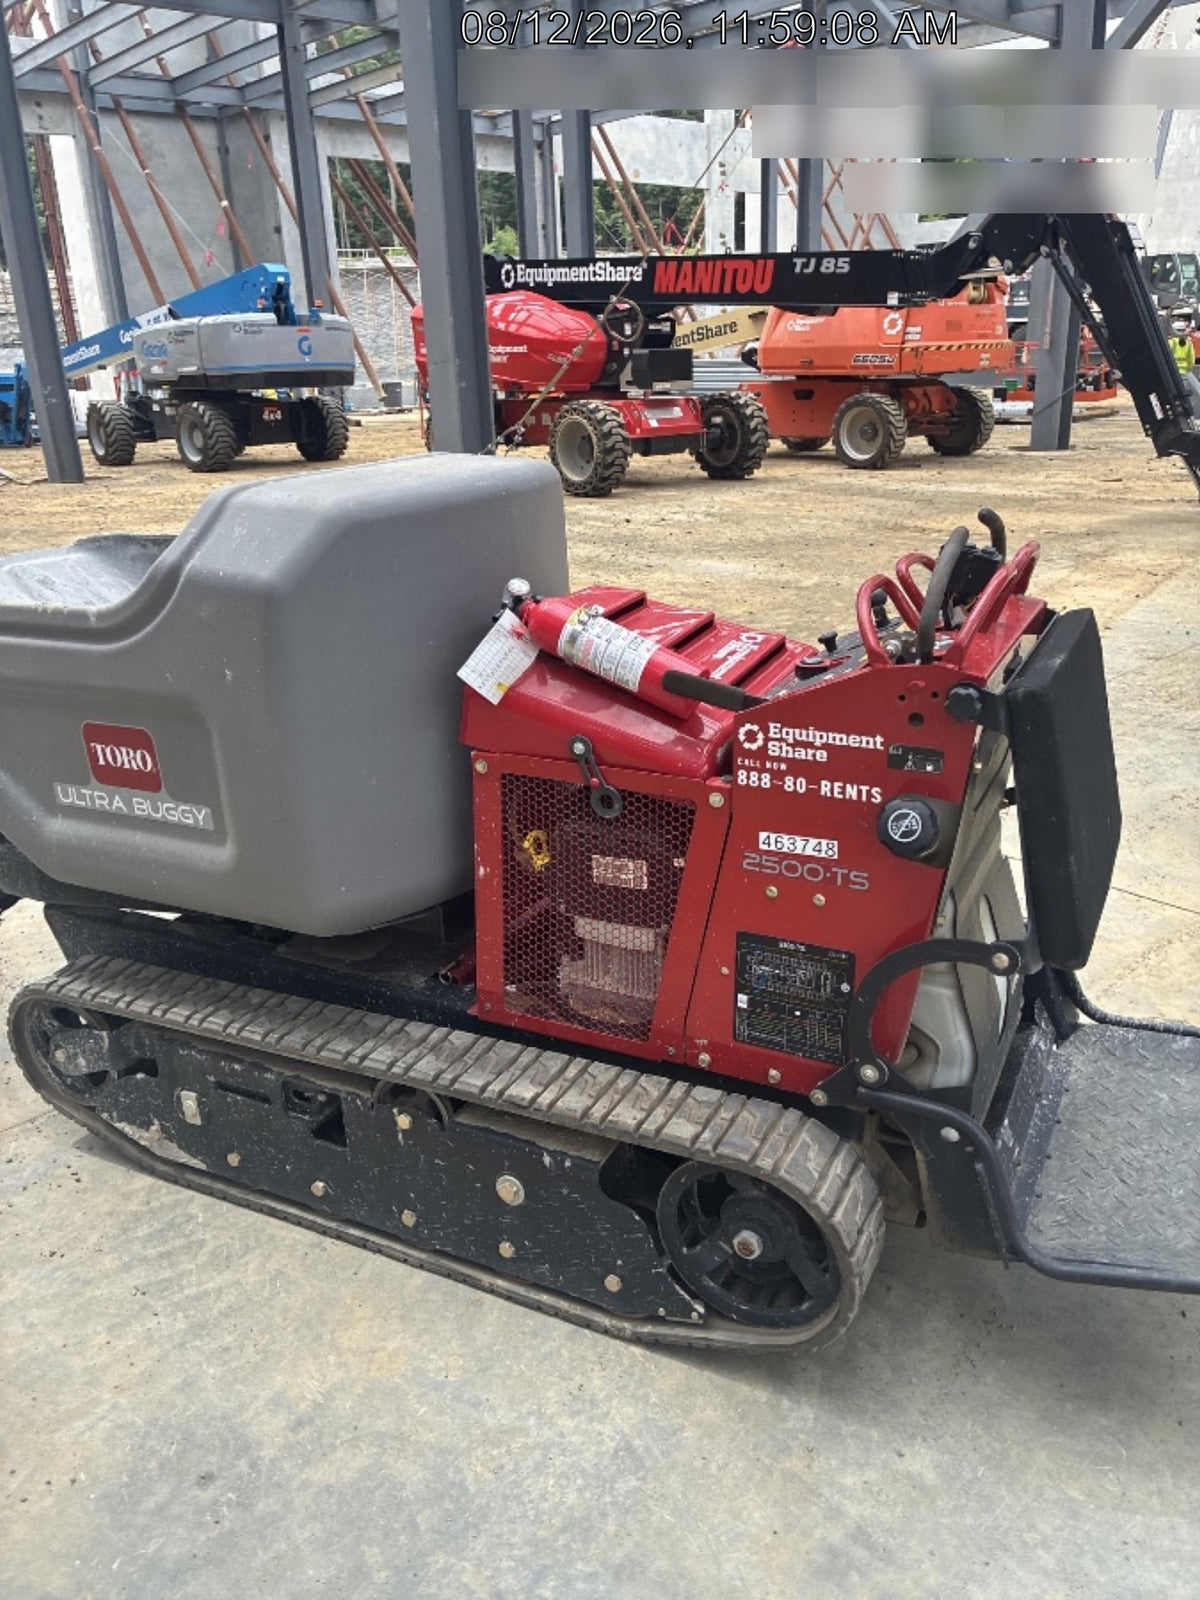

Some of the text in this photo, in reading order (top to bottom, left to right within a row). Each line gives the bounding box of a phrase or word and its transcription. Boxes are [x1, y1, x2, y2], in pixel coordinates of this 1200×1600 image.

[516, 261, 643, 287] EquipmentShare
[653, 258, 775, 294] MANITOU
[792, 257, 850, 273] TJ 85
[767, 721, 885, 751] Equipment
[90, 742, 153, 772] TORO
[737, 757, 787, 771] CALL NOW
[767, 741, 828, 762] Share
[737, 769, 883, 804] 888-80-RENTS
[57, 786, 206, 826] ULTRA BUGGY
[761, 834, 836, 858] 463748
